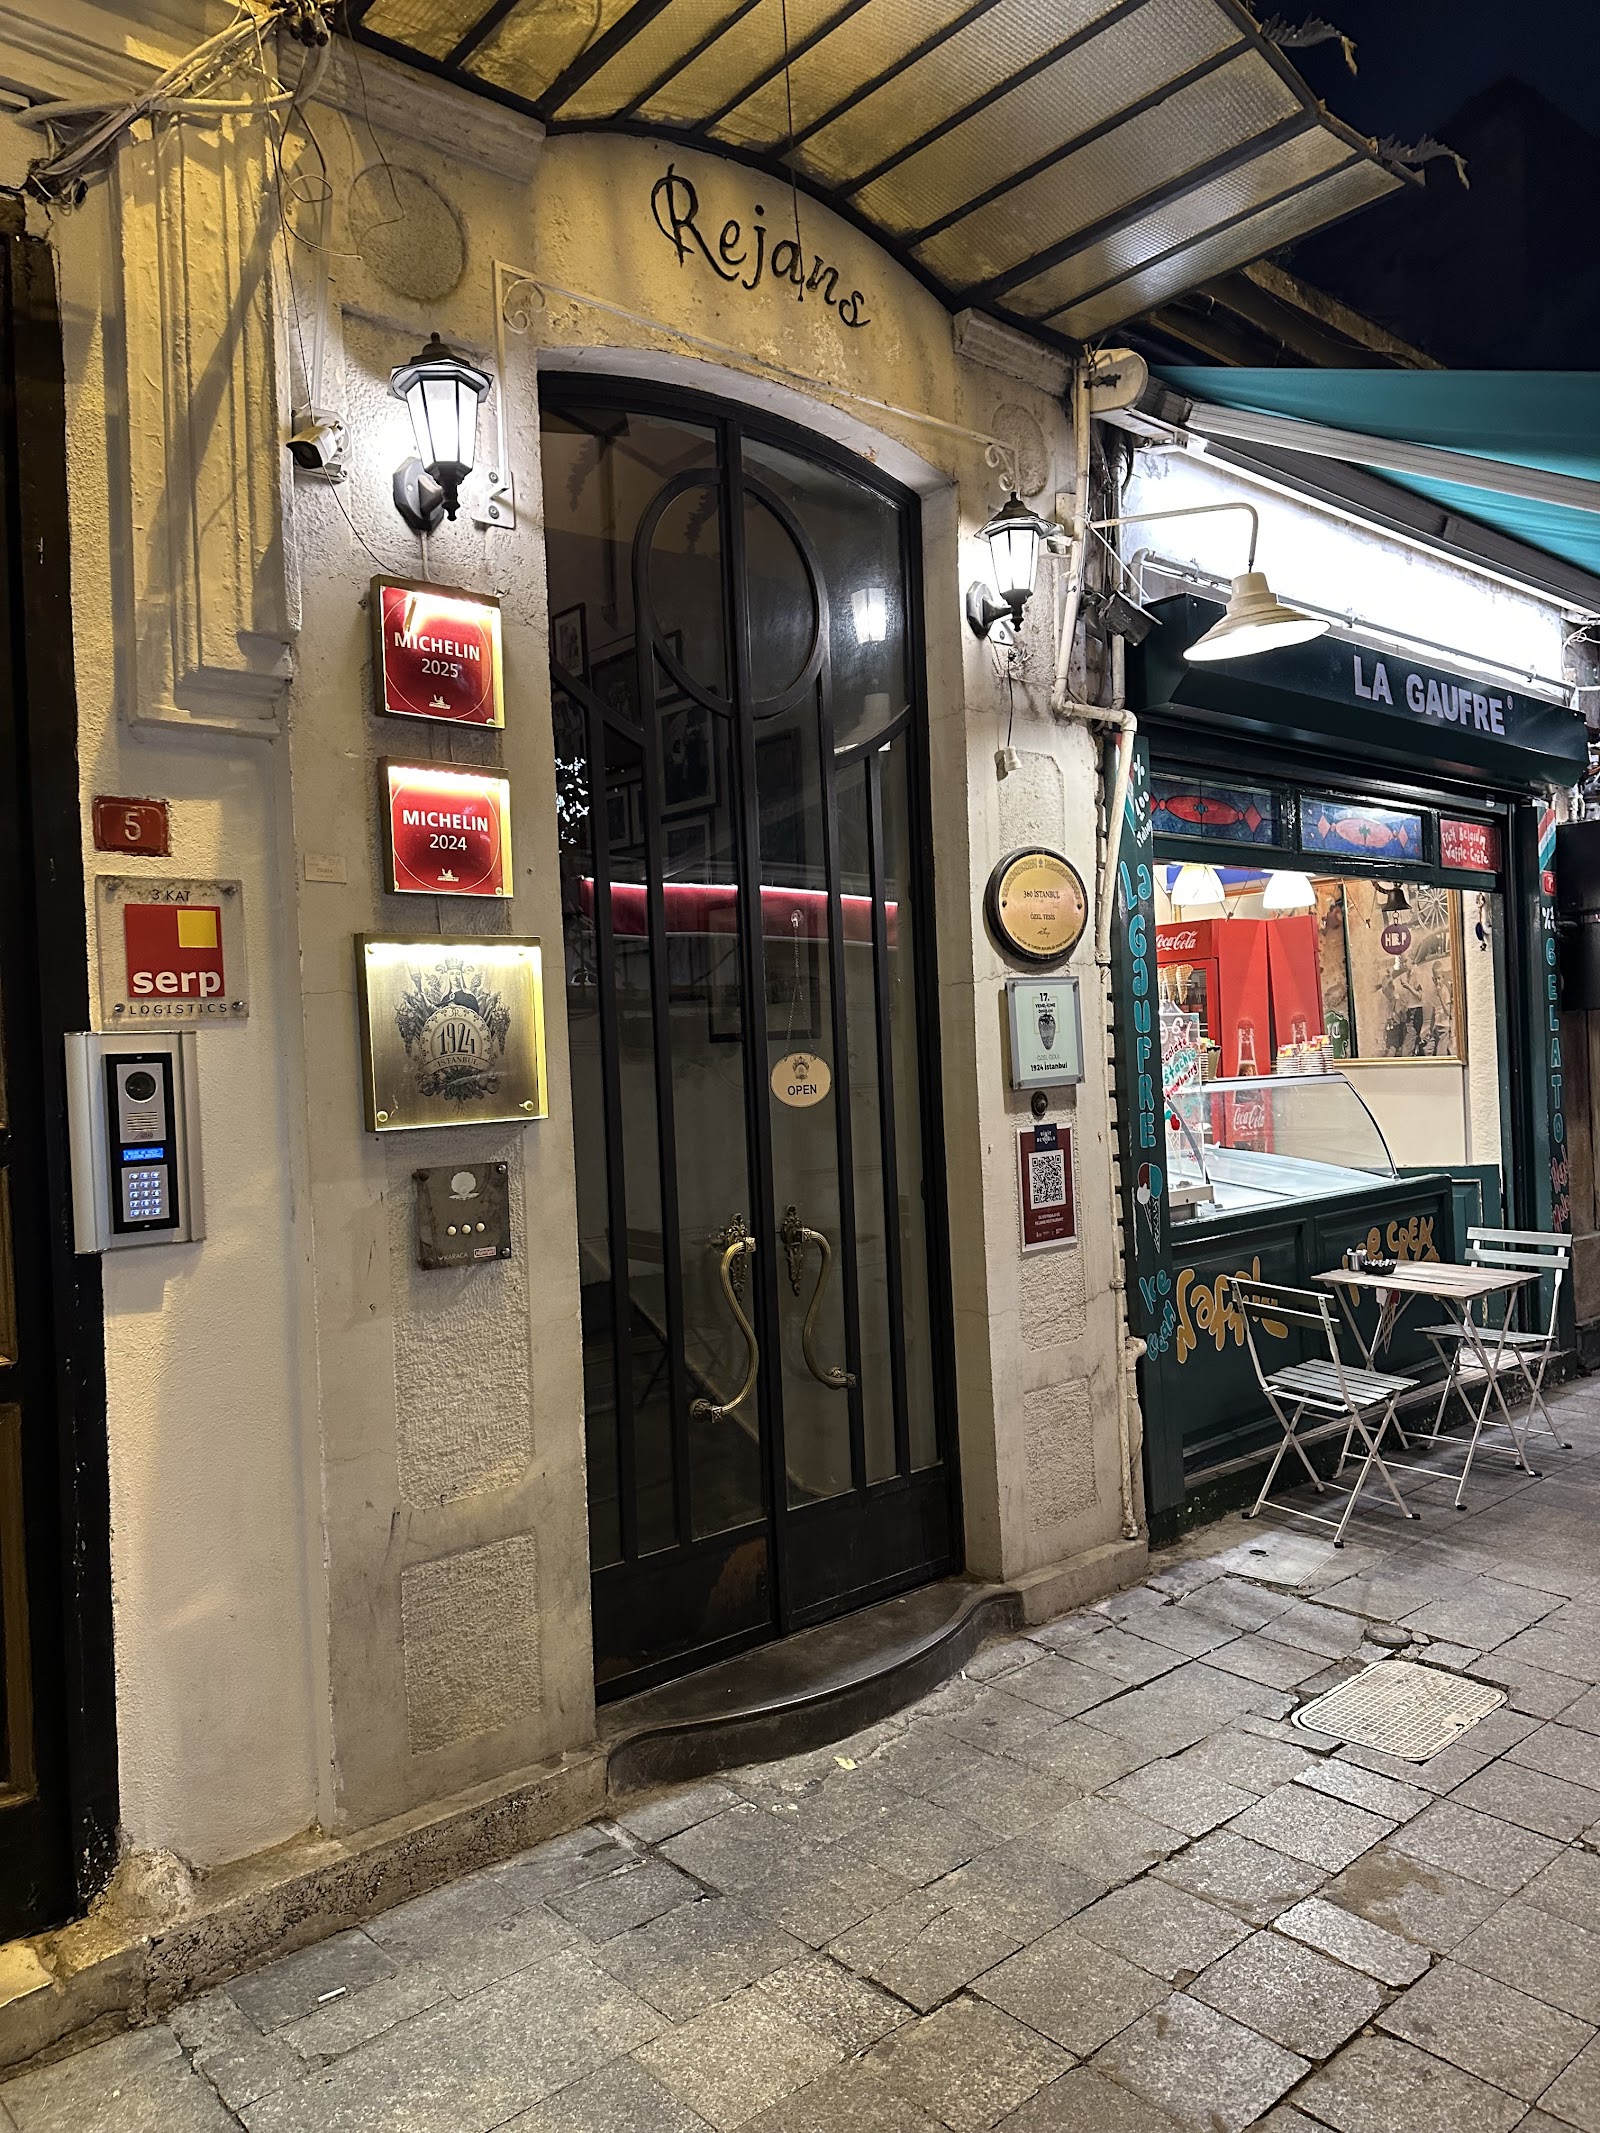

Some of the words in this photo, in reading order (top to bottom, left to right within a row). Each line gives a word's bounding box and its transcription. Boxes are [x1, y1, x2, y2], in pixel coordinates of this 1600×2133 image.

[651, 163, 871, 328] Rejans
[394, 632, 480, 662] MICHELIN
[421, 658, 459, 678] 2025
[1353, 655, 1393, 705] LA
[1406, 673, 1505, 735] GAUFRE
[124, 811, 141, 841] 5
[402, 809, 488, 832] MICHELIN
[429, 833, 467, 851] 2024
[166, 890, 191, 901] KAT
[133, 970, 221, 998] serp
[130, 1003, 227, 1016] LOGISTICS
[437, 1022, 475, 1055] 1924
[787, 1084, 817, 1096] OPEN
